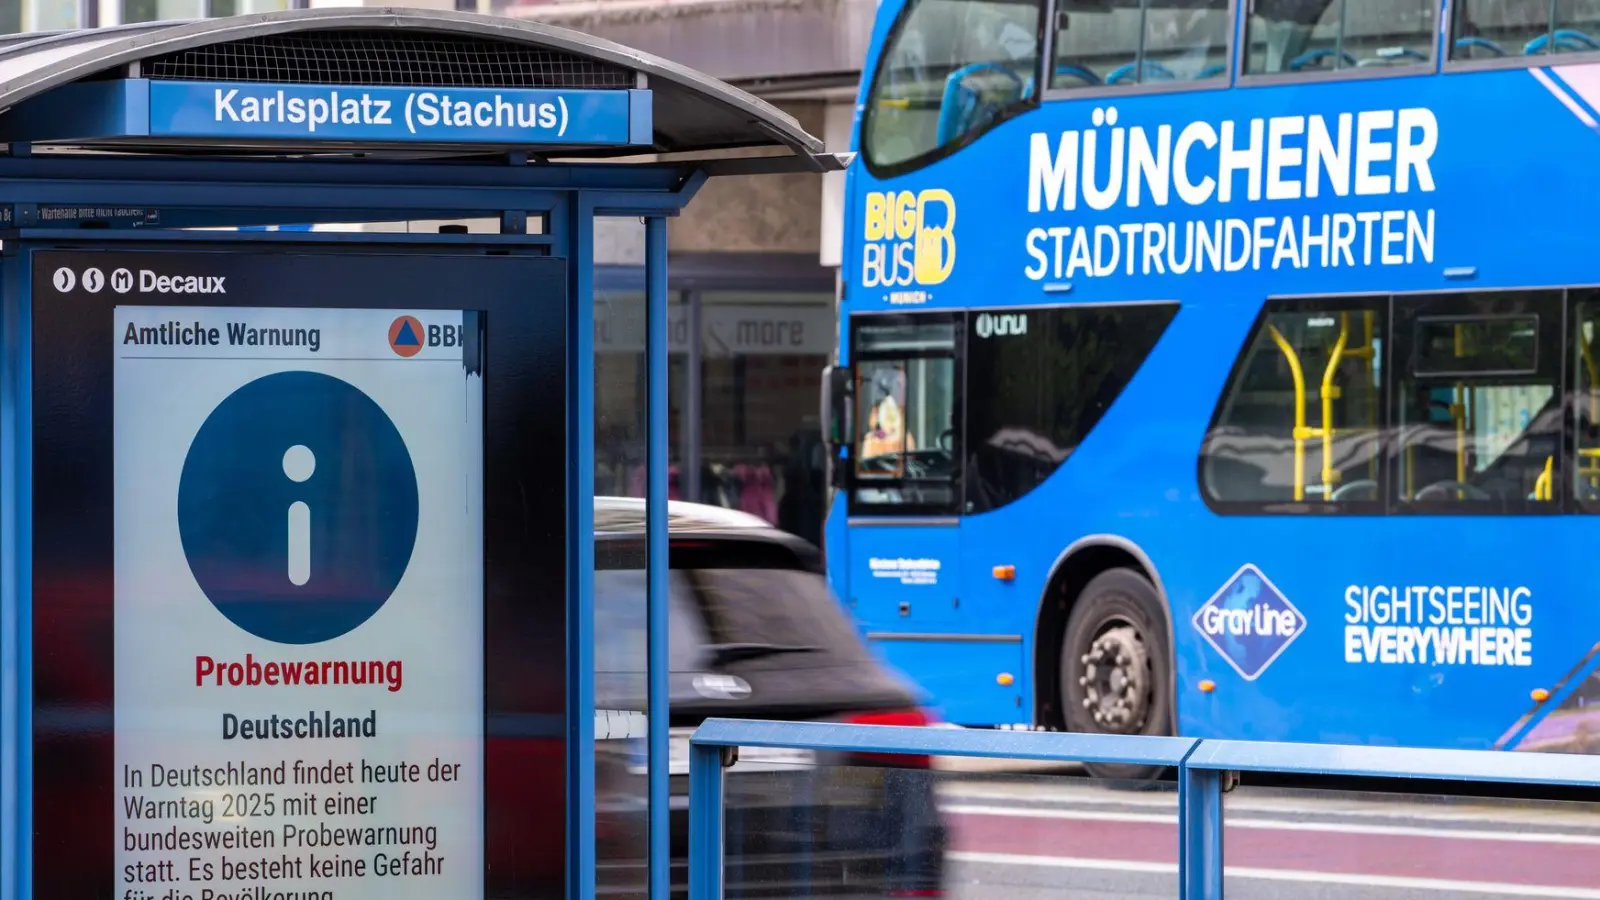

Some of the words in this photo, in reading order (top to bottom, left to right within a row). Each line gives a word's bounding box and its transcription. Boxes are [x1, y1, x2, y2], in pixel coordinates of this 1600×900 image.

[214, 88, 393, 132] Karlsplatz
[404, 92, 569, 137] (Stachus)
[1027, 106, 1439, 213] MÜNCHENER
[864, 190, 916, 241] BIG
[1024, 208, 1436, 281] STADTRUNDFAHRTEN
[139, 270, 226, 293] Decaux
[862, 241, 914, 287] BUS
[123, 321, 220, 346] Amtliche
[226, 322, 321, 352] Warnung
[736, 318, 804, 346] more
[1344, 584, 1532, 626] SIGHTSEEING
[1344, 625, 1532, 666] EVERYWHERE
[196, 653, 403, 692] Probewarnung
[222, 709, 377, 740] Deutschland
[124, 764, 143, 788] In
[151, 760, 286, 788] Deutschland
[293, 759, 354, 784] findet
[361, 759, 421, 783] heute
[427, 757, 461, 782] der
[123, 795, 214, 824] Warntag
[221, 793, 276, 817] 2025
[283, 792, 318, 816] mit
[324, 791, 378, 816] einer
[124, 825, 275, 851] bundesweiten
[283, 822, 437, 850] Probewarnung
[124, 859, 181, 883] statt.
[189, 857, 214, 881] Es
[221, 855, 302, 880] besteht
[310, 853, 366, 878] keine
[373, 851, 445, 877] Gefahr
